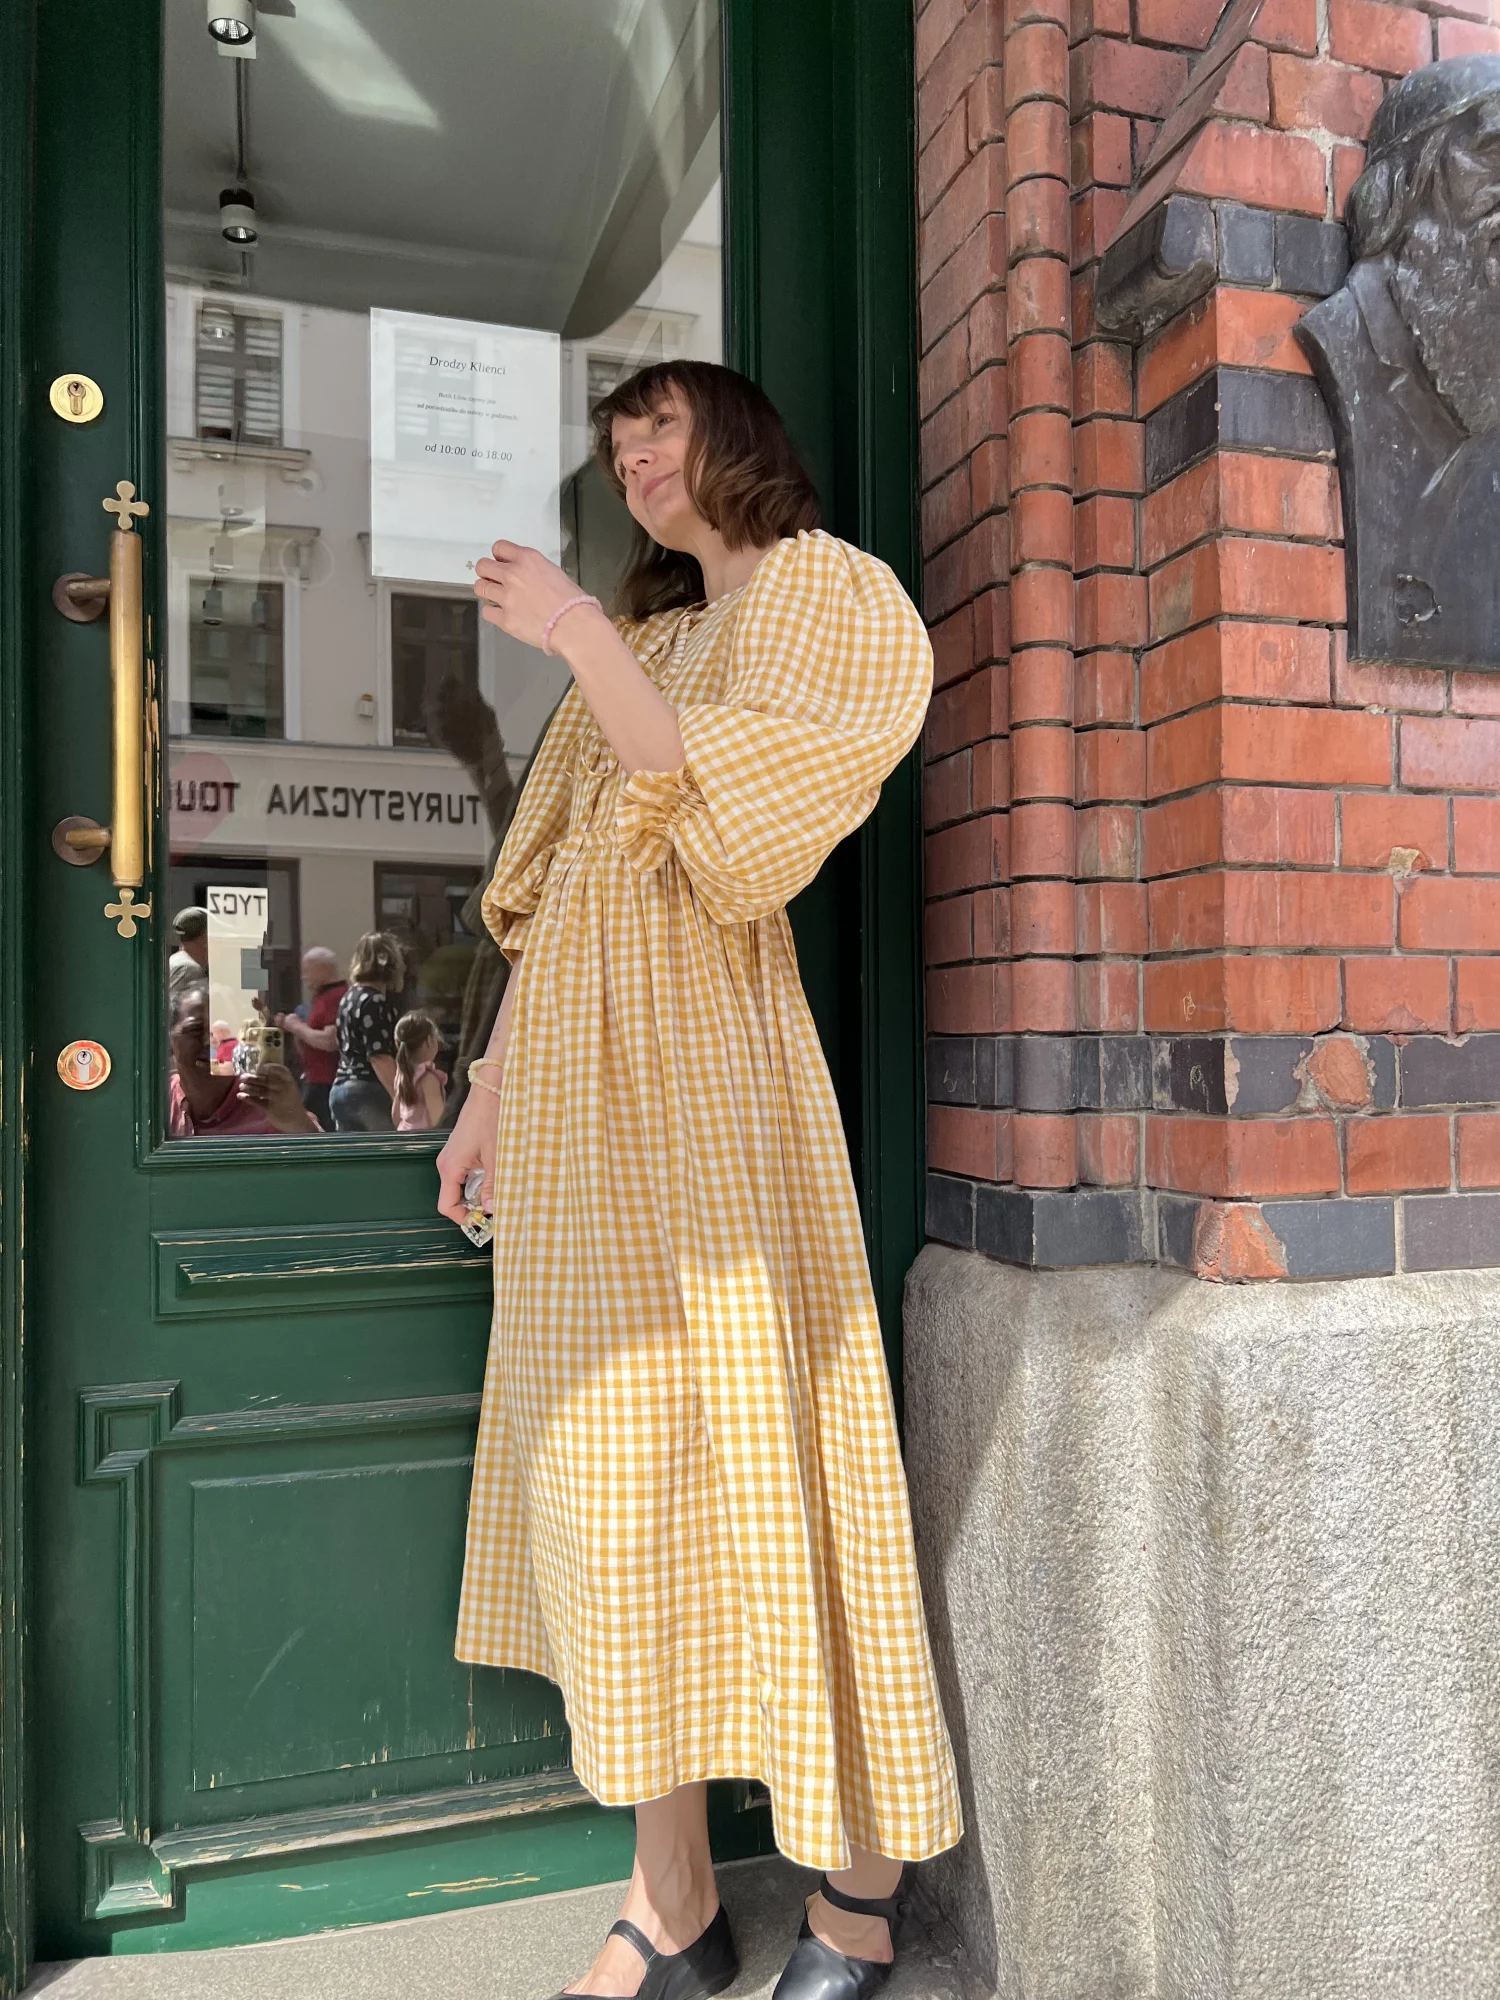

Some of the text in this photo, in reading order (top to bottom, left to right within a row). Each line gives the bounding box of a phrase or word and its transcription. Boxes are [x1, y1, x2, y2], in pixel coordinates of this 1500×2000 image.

[429, 356, 507, 376] Drodzy Klienci
[424, 443, 513, 462] od 10:00 do 18:00
